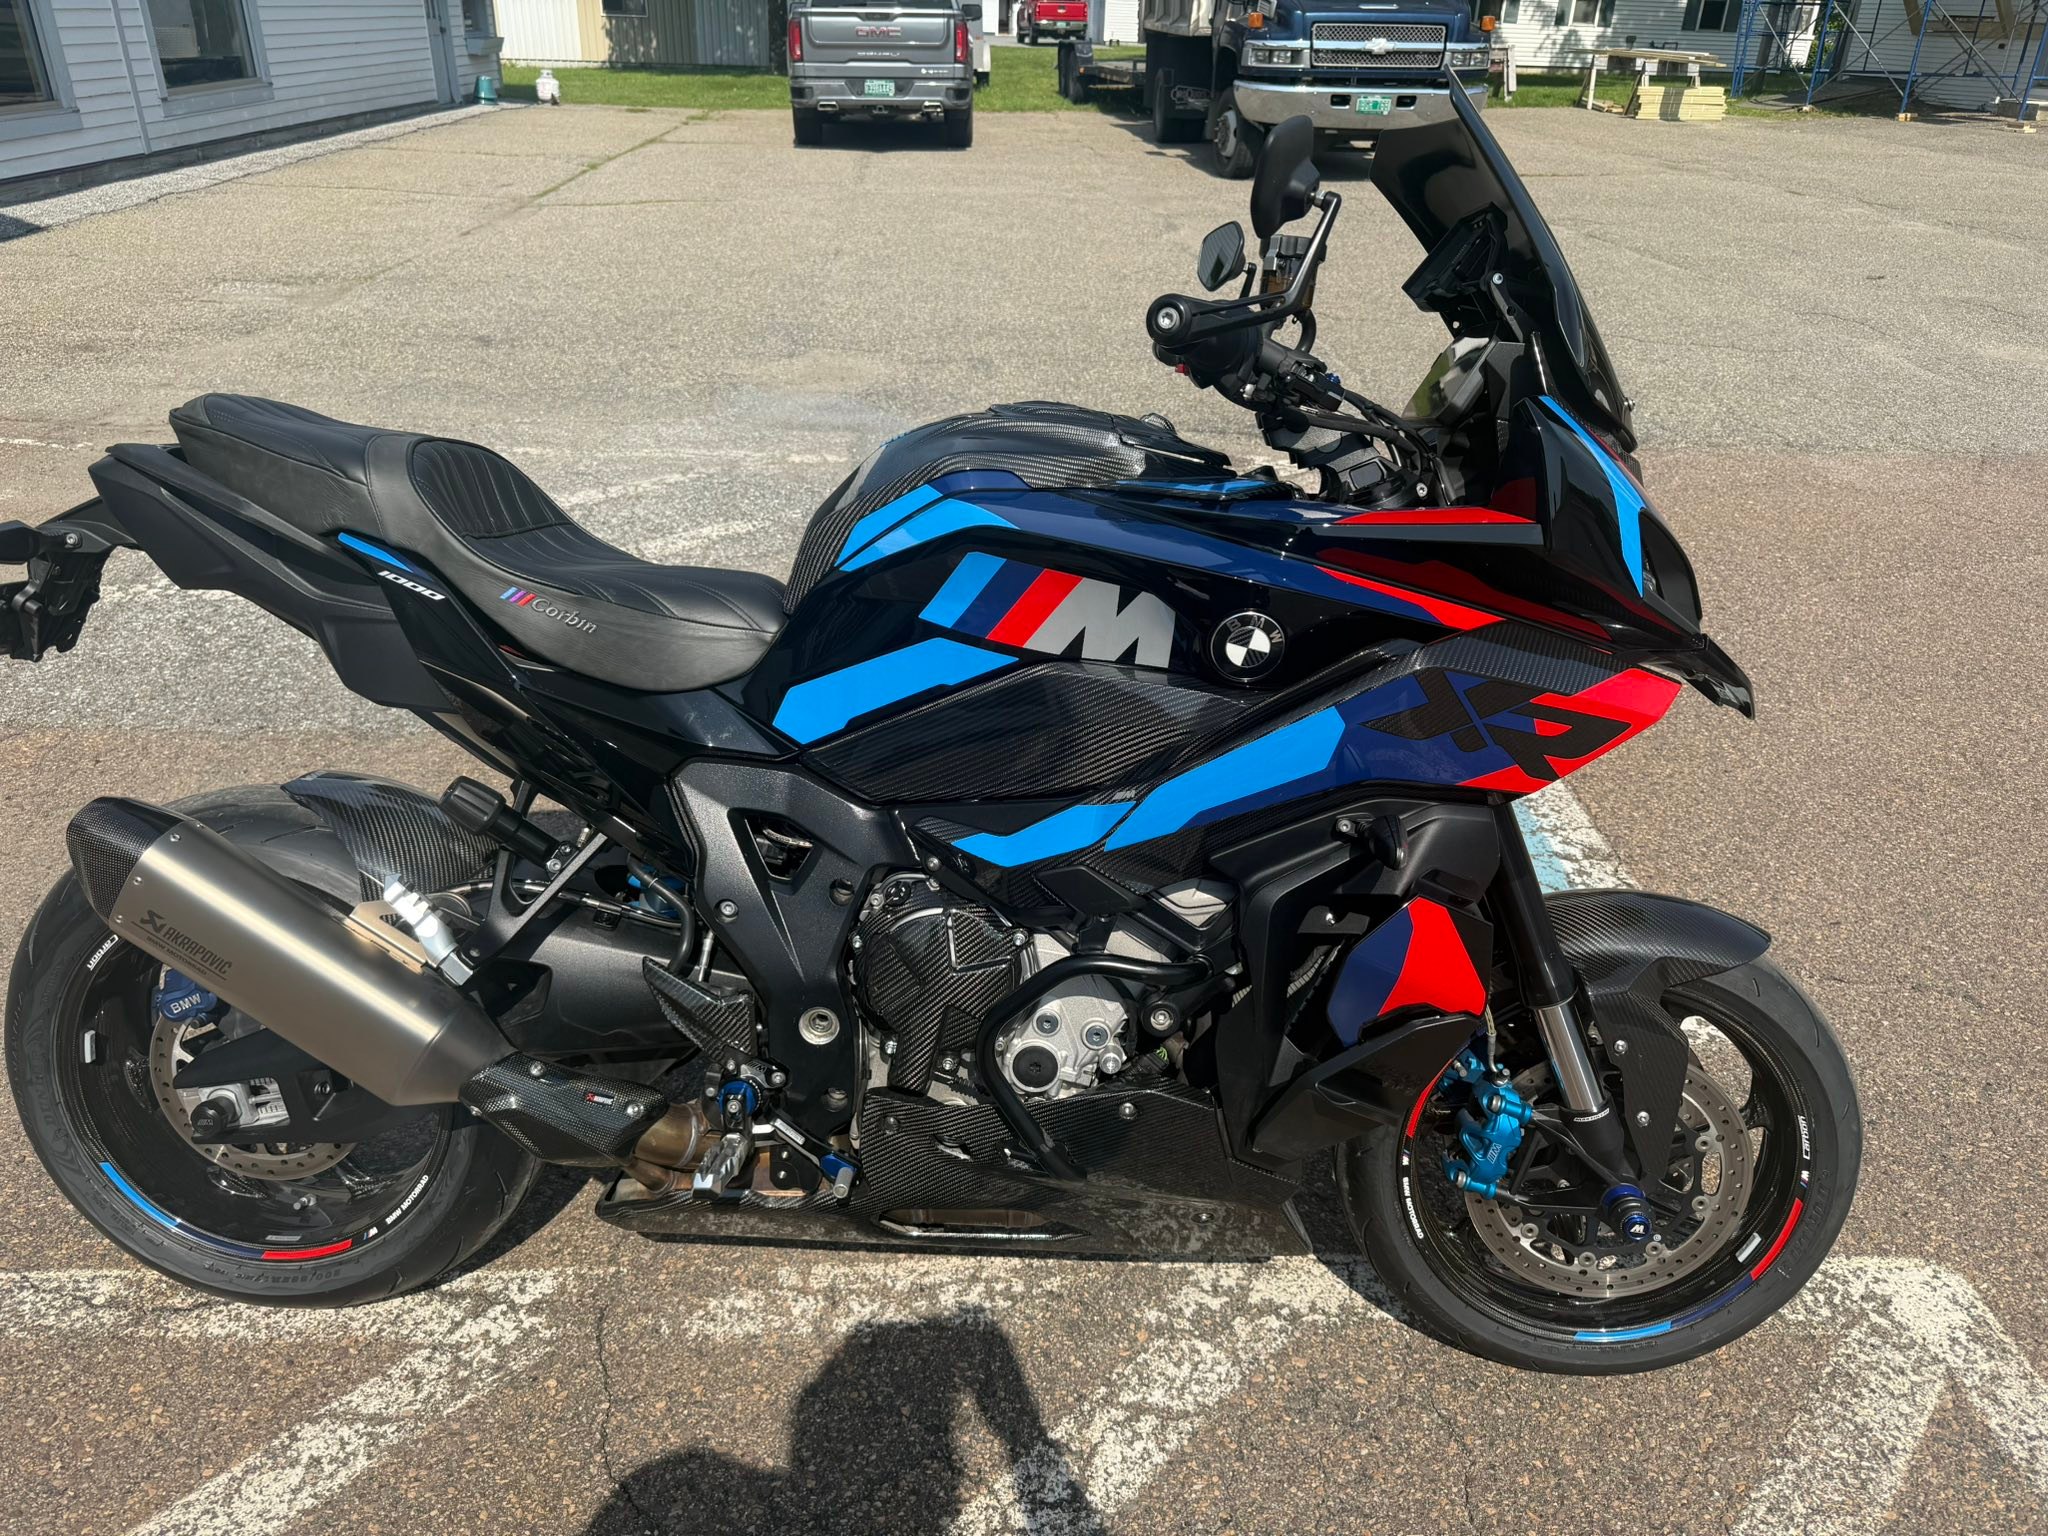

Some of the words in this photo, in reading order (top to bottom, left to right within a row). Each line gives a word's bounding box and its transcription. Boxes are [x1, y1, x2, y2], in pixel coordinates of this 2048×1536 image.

[855, 26, 902, 37] GMC
[377, 569, 447, 601] 1000
[530, 597, 598, 634] Corbin
[1226, 614, 1284, 643] BMW
[1356, 665, 1633, 783] XR
[169, 992, 202, 1014] BMW
[385, 1207, 402, 1225] BMW
[400, 1175, 429, 1211] MOTORRAD
[1402, 1176, 1411, 1197] BMW
[1405, 1197, 1424, 1239] MOTORRAD
[1629, 1224, 1646, 1235] M
